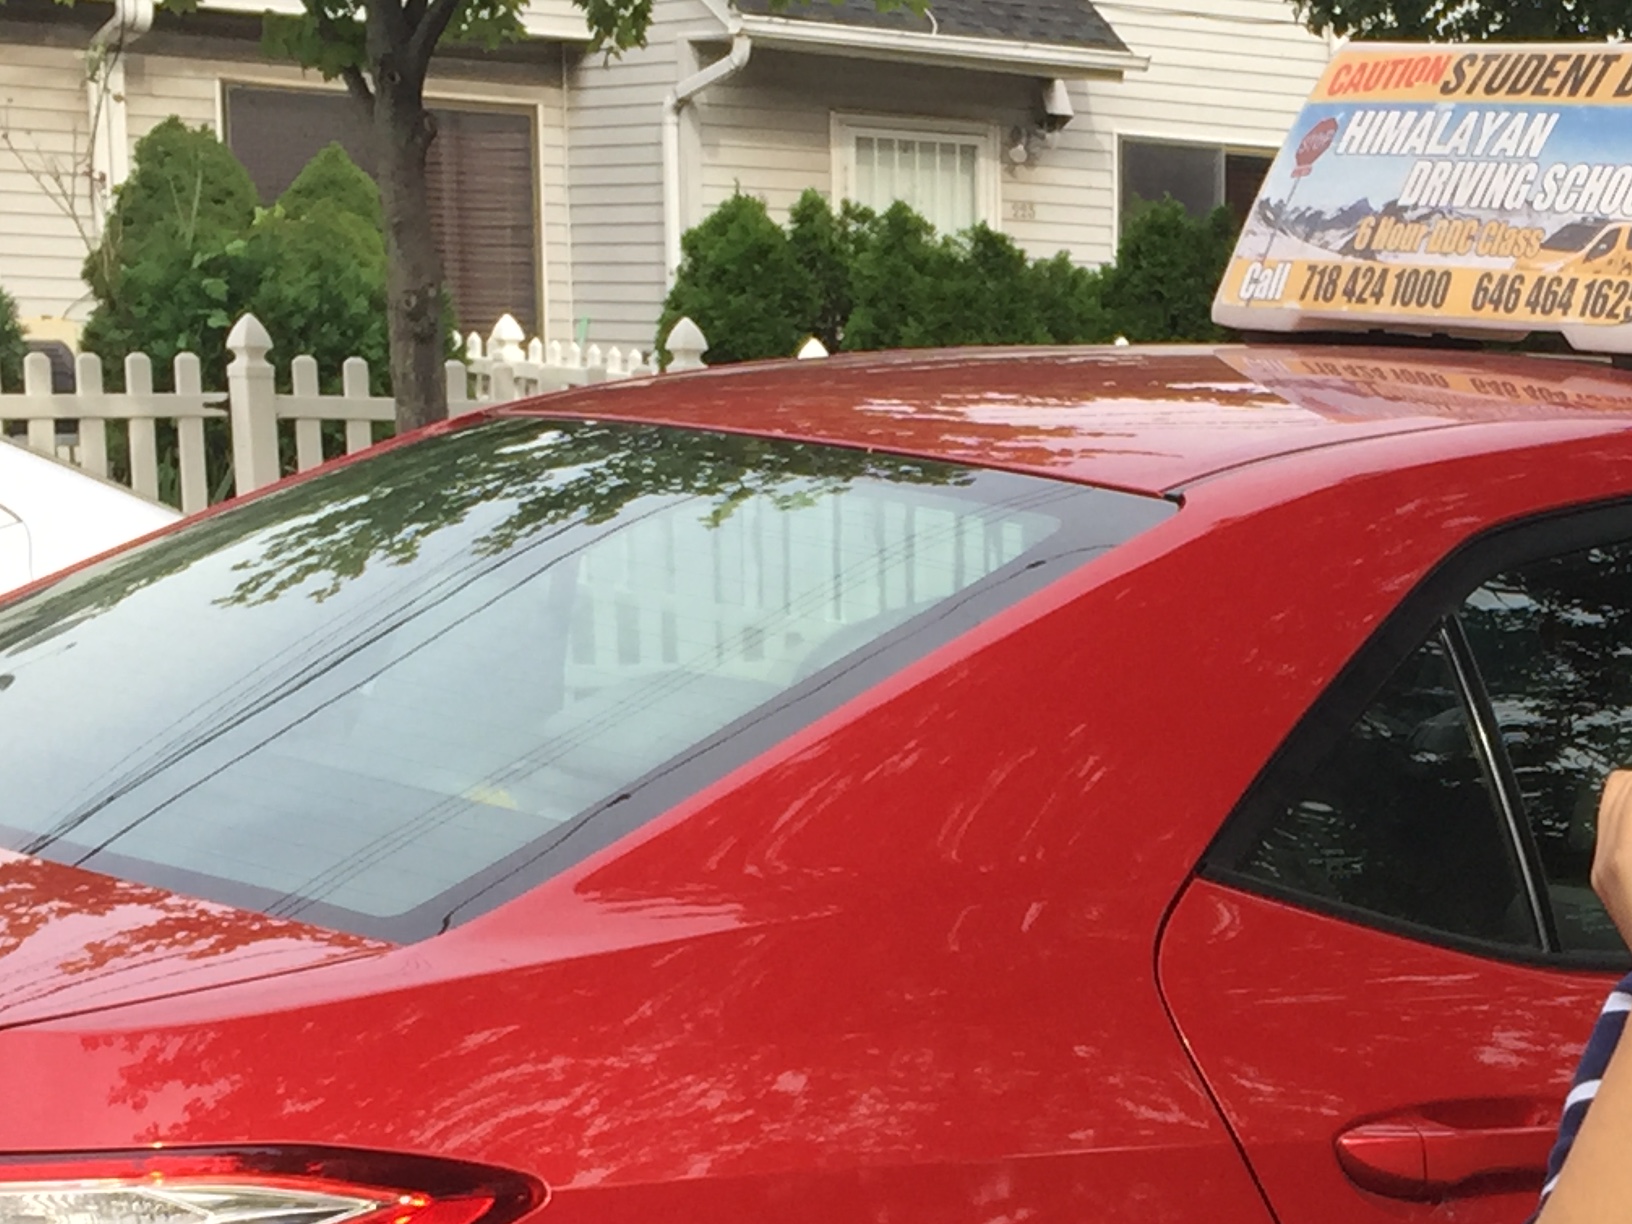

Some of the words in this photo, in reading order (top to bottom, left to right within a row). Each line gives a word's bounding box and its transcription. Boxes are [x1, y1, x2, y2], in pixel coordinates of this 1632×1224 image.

[1327, 55, 1450, 97] CAUTION
[1440, 53, 1622, 98] STUDENT
[1336, 110, 1559, 158] HIMALAYAN
[1398, 161, 1537, 210] DRIVING
[1353, 216, 1375, 250] 6
[1373, 217, 1427, 252] Hour
[1426, 219, 1475, 255] DDC
[1476, 221, 1546, 258] Class
[1238, 260, 1292, 302] Call
[1299, 264, 1342, 303] 718
[1342, 266, 1389, 305] 424
[1390, 268, 1453, 309] 1000
[1471, 272, 1525, 314] 646
[1525, 275, 1579, 317] 464
